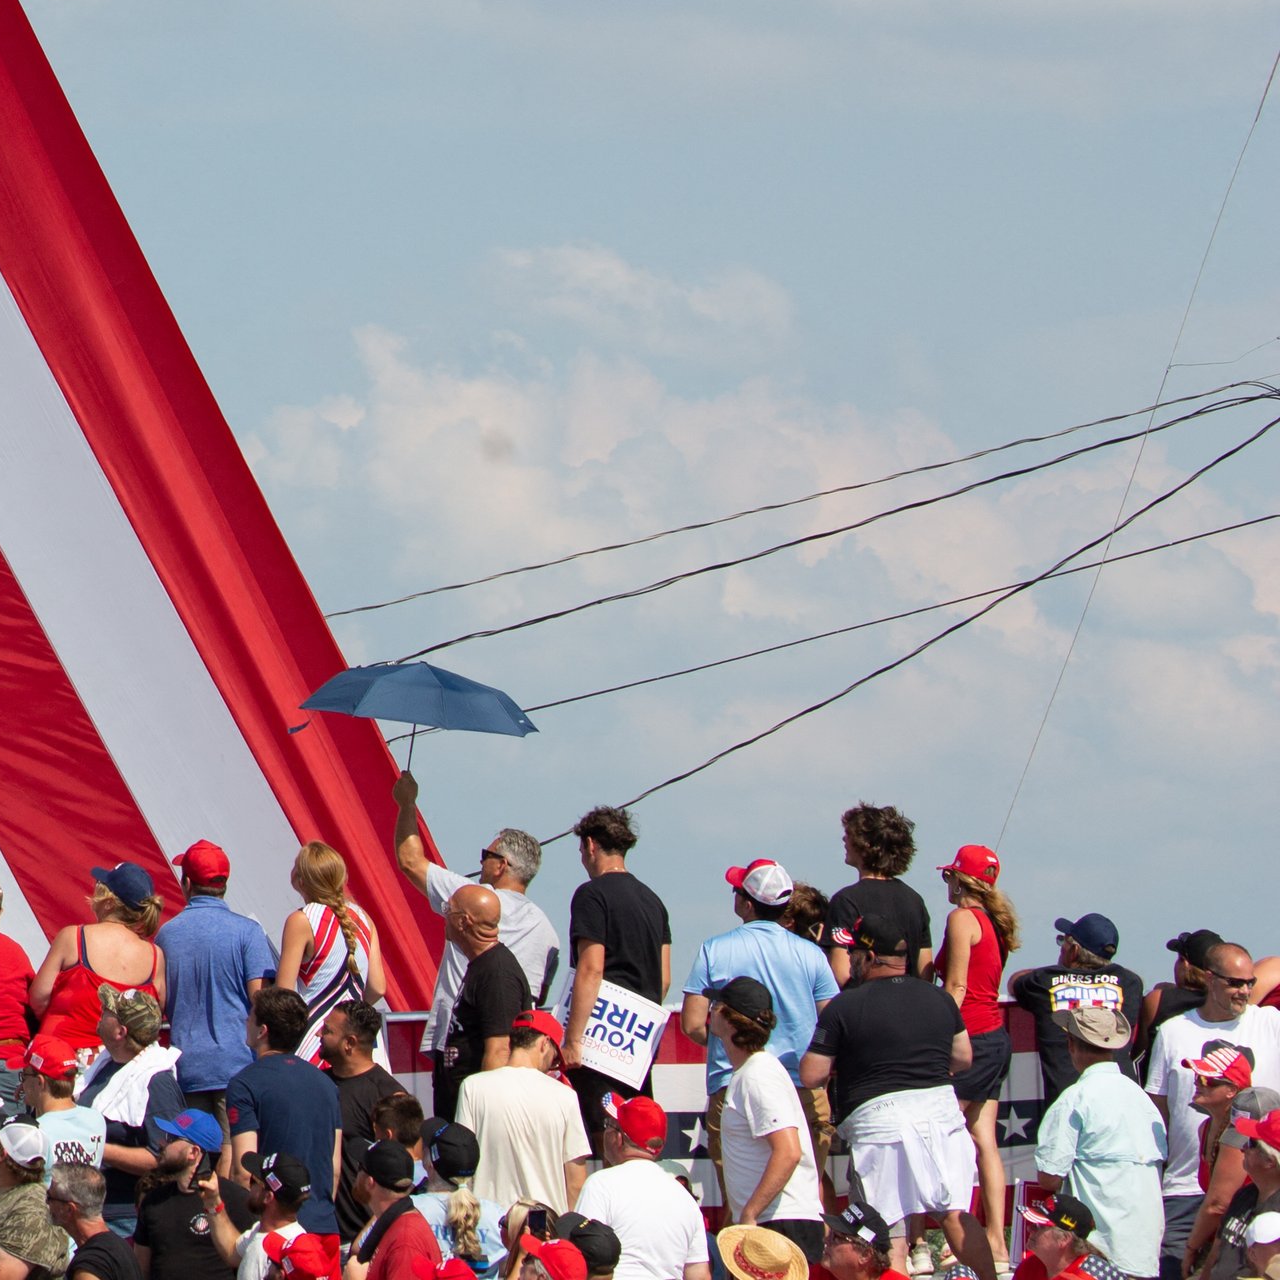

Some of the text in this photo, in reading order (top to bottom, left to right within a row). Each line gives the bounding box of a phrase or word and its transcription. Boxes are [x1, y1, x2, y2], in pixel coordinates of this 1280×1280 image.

[1051, 973, 1119, 986] BIKERS FOR
[1055, 987, 1119, 1001] TRUMP
[580, 1037, 635, 1065] CROOKED
